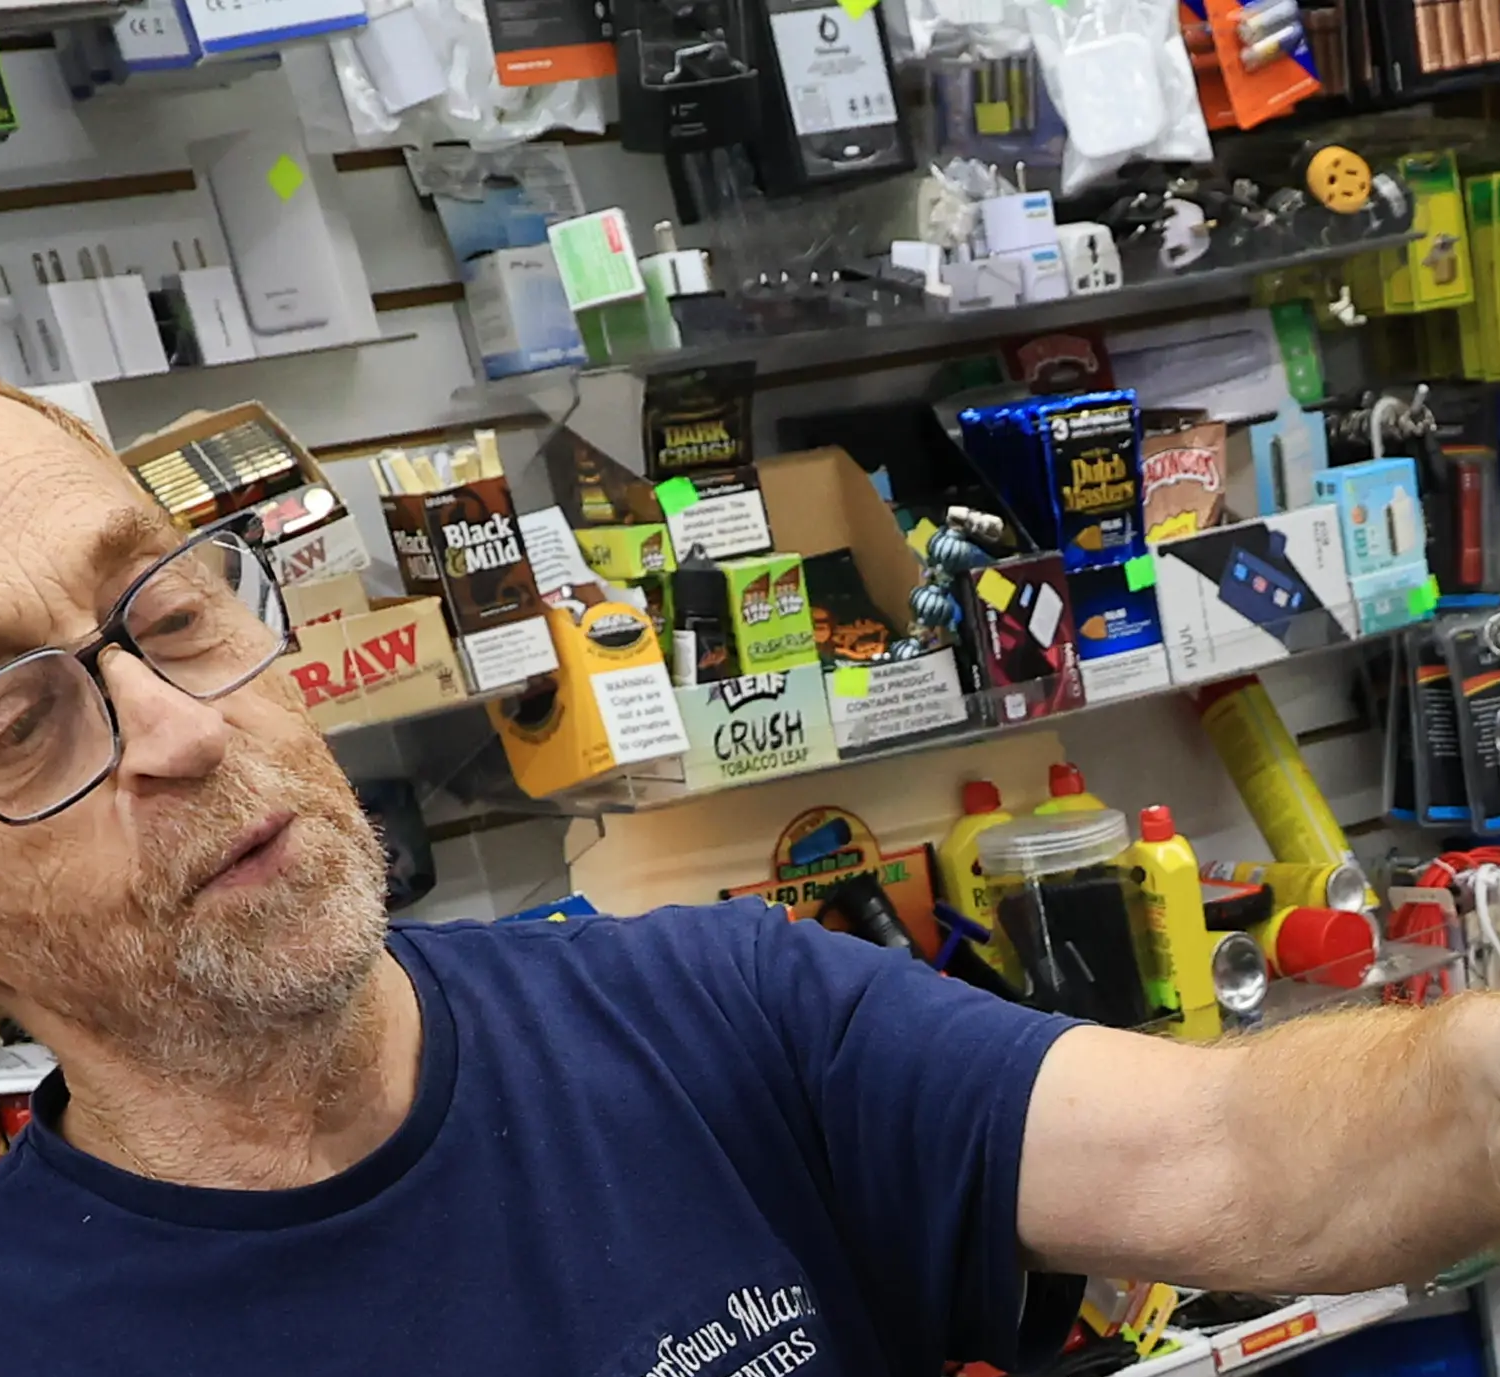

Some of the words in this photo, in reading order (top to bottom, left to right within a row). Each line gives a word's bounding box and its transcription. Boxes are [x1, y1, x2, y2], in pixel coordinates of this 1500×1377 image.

[1071, 453, 1126, 486] Dutch
[442, 514, 512, 550] Black
[288, 622, 420, 711] RAW
[713, 709, 804, 760] CRUSH
[719, 752, 779, 779] TOBACCO
[781, 748, 810, 766] LEAF
